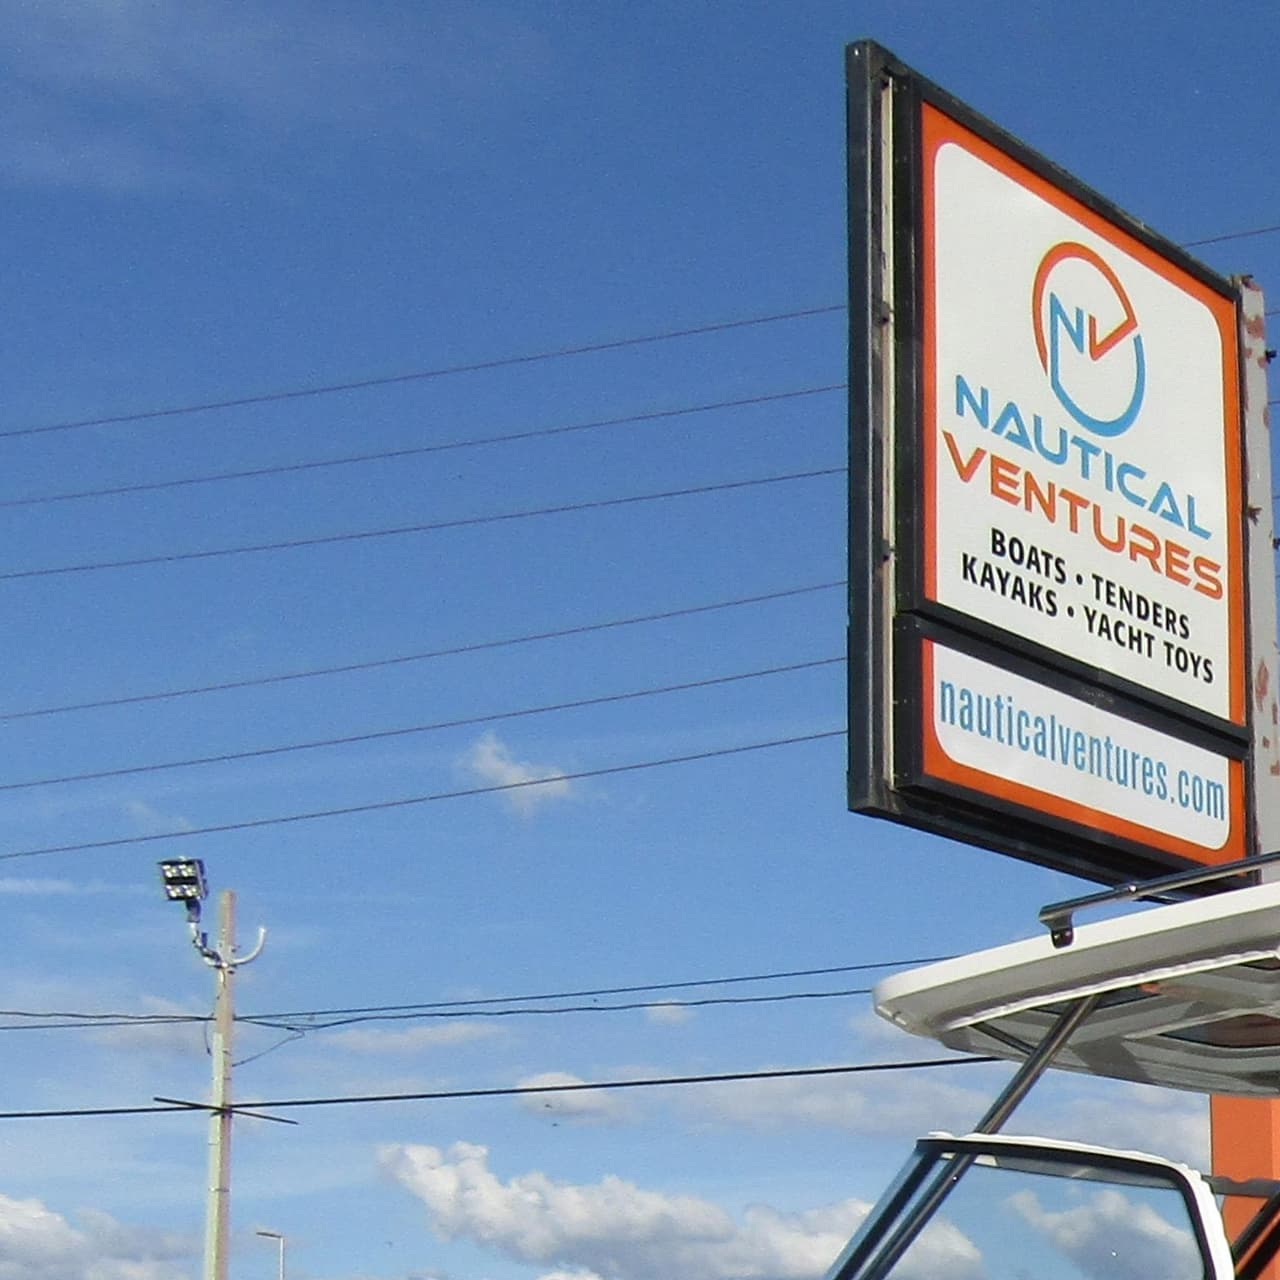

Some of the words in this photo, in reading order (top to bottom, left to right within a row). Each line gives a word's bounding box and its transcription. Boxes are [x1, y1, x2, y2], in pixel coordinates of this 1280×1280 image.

[942, 430, 1224, 600] VENTURES
[955, 374, 1212, 540] NAUTICAL
[961, 553, 1058, 617] KAYAKS
[1084, 605, 1155, 658] YACHT
[1163, 641, 1214, 684] TOYS
[991, 528, 1066, 585] BOATS
[1091, 574, 1190, 639] TENDERS
[940, 679, 1226, 821] nauticalventures.com
